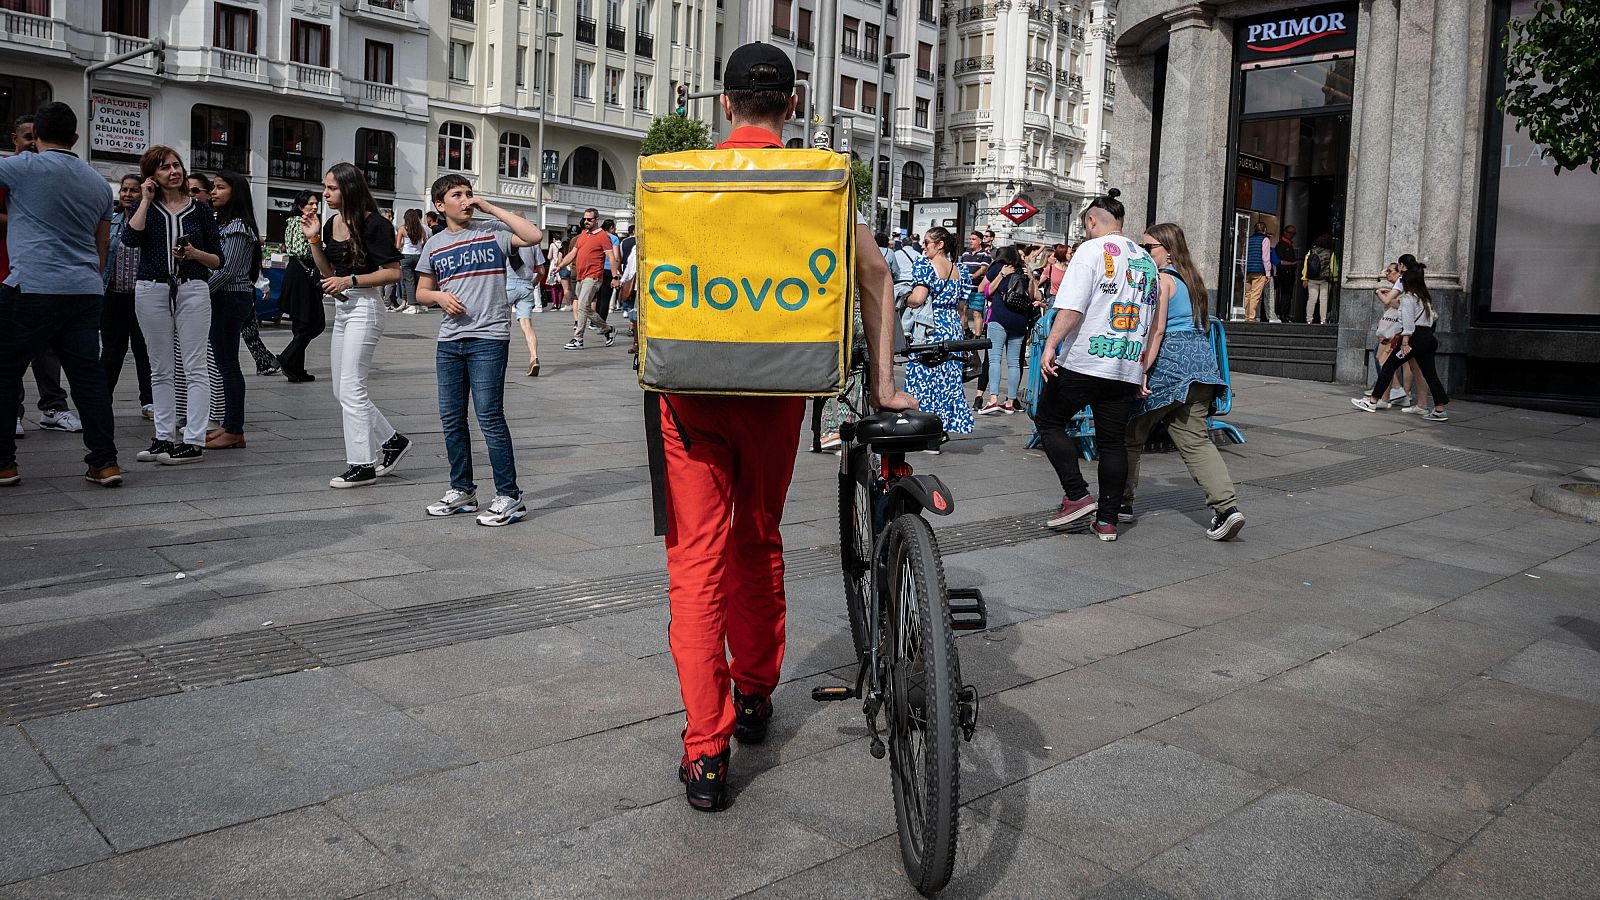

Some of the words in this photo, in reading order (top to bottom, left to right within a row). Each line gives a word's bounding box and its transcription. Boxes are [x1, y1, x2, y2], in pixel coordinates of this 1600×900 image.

[1247, 12, 1347, 43] PRIMOR
[106, 98, 148, 109] ALQUILER
[99, 107, 142, 118] OFICINAS
[99, 116, 128, 126] SALAS
[129, 120, 141, 128] DE
[95, 124, 145, 137] REUNIONES
[105, 139, 121, 147] 104
[123, 141, 134, 149] 26
[457, 248, 494, 266] JEANS
